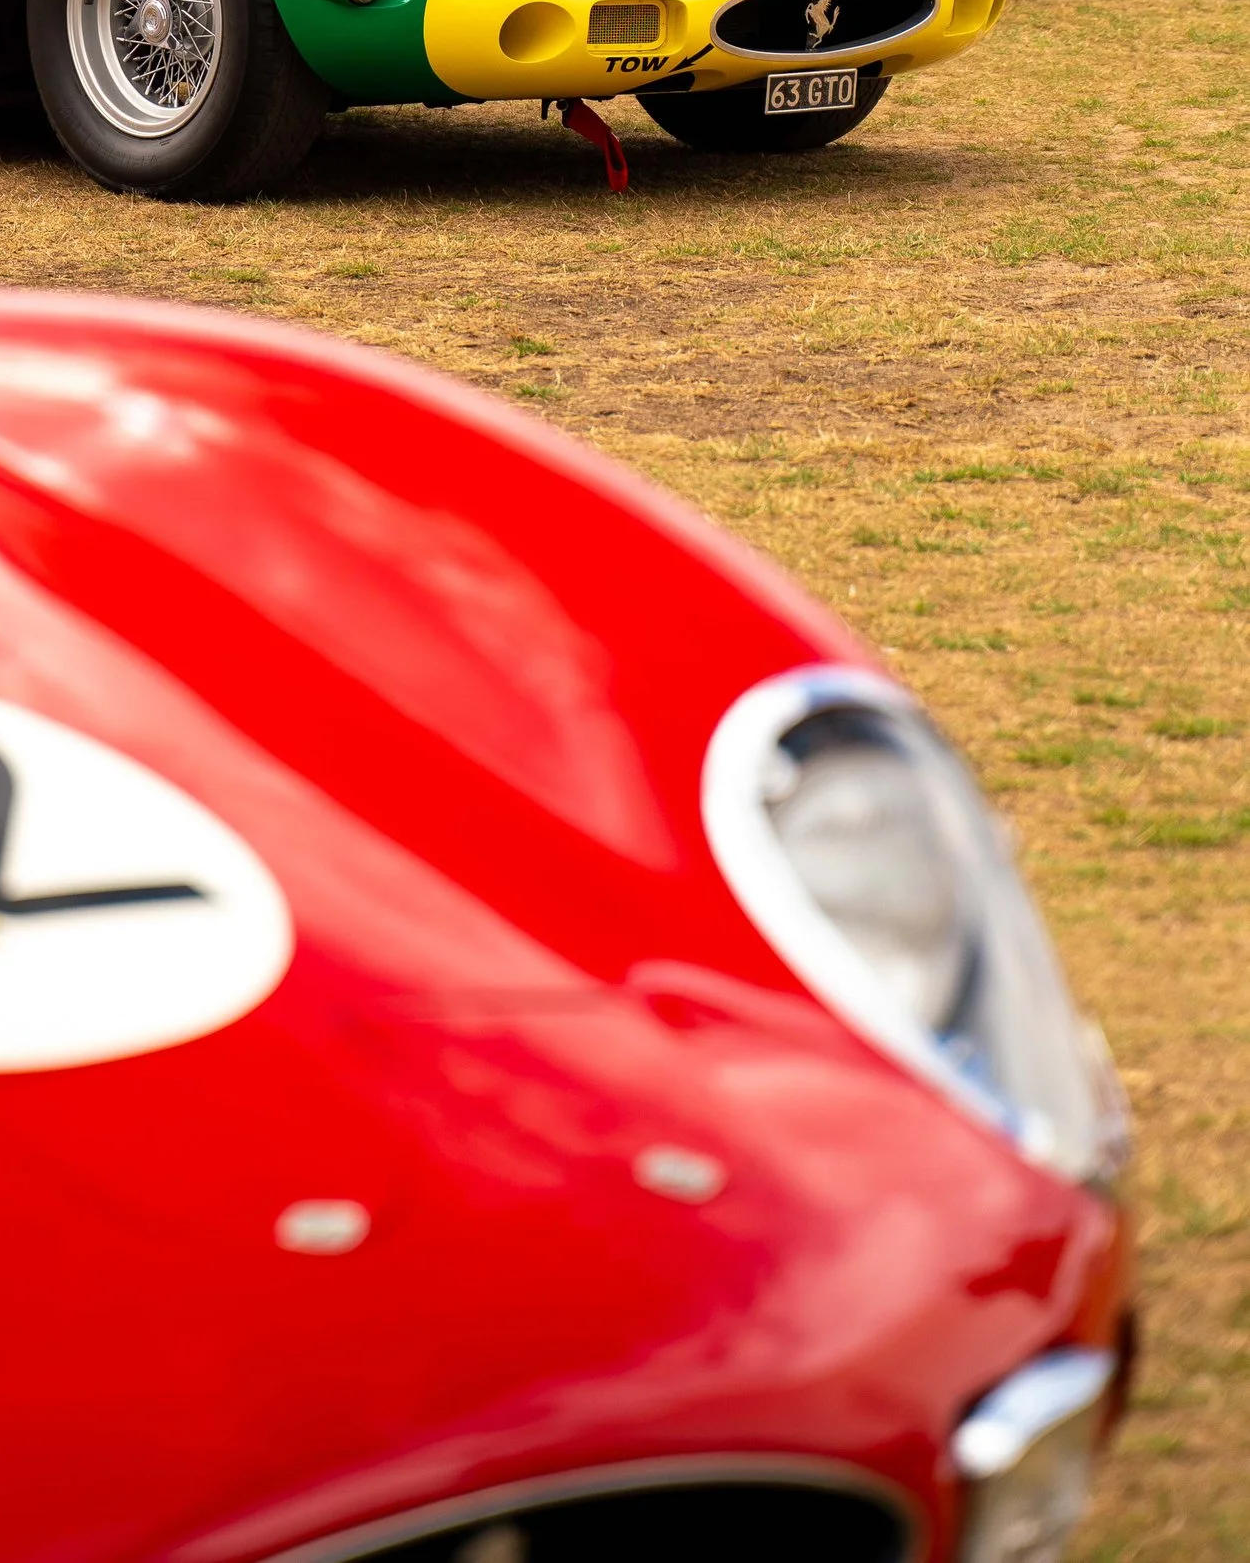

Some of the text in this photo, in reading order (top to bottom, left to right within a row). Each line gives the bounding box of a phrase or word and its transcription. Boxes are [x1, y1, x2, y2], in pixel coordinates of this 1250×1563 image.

[604, 56, 670, 73] TOW
[770, 74, 853, 109] 63 GTO
